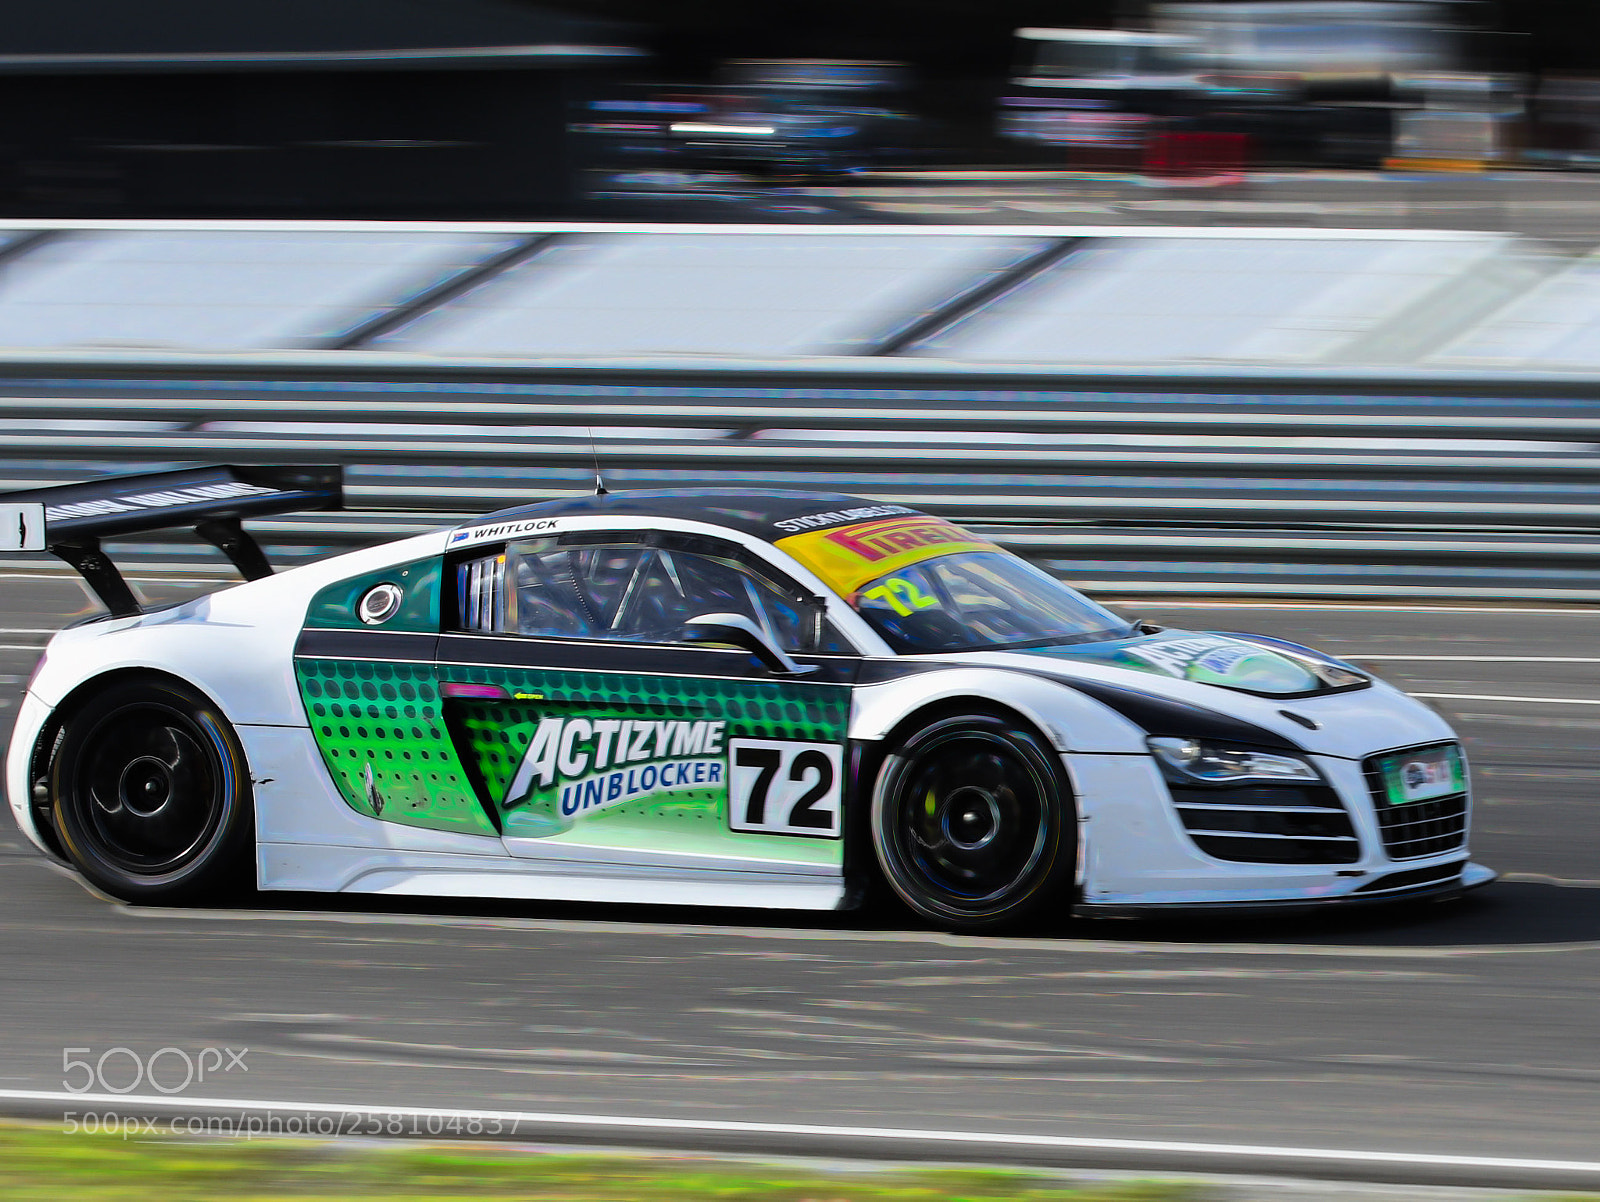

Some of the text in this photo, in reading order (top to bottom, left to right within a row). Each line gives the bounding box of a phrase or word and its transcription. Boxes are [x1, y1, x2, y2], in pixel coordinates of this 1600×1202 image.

[474, 520, 560, 538] WHITLOCK
[863, 578, 939, 617] 72
[503, 717, 726, 804] ACTIZYME
[562, 762, 722, 816] UNBLOCKER
[735, 747, 834, 830] 72
